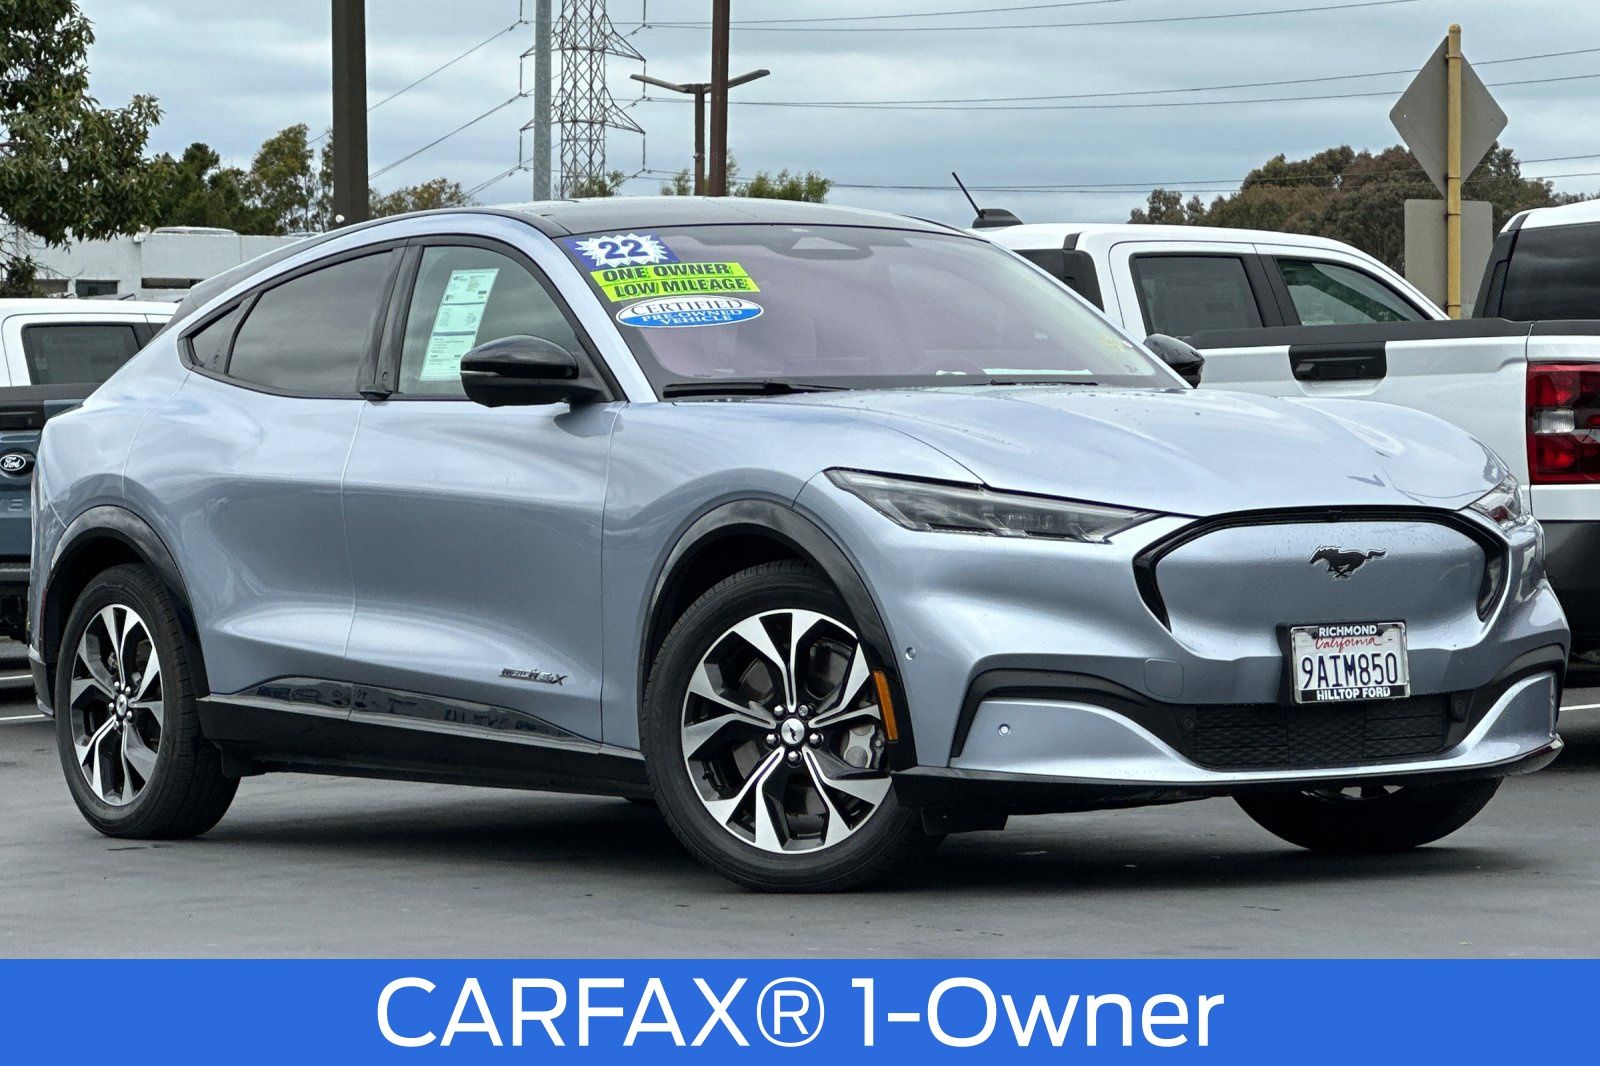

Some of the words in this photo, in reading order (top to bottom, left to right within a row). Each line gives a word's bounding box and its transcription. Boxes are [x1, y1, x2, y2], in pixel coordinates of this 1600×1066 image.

[597, 238, 650, 260] 22
[602, 267, 649, 283] ONE
[653, 262, 732, 278] OWNER
[614, 282, 659, 298] LOW
[662, 277, 750, 294] MILEAGE
[630, 299, 743, 316] CERTIFIED
[641, 308, 743, 322] PRE-OWNED
[660, 315, 732, 325] VEHICLE
[3, 456, 21, 468] Ford
[1318, 625, 1378, 637] RICHMOND
[1315, 636, 1382, 653] California
[1301, 652, 1398, 689] 9AIM850
[1316, 688, 1360, 701] HILLTOP
[1362, 687, 1391, 698] FORD
